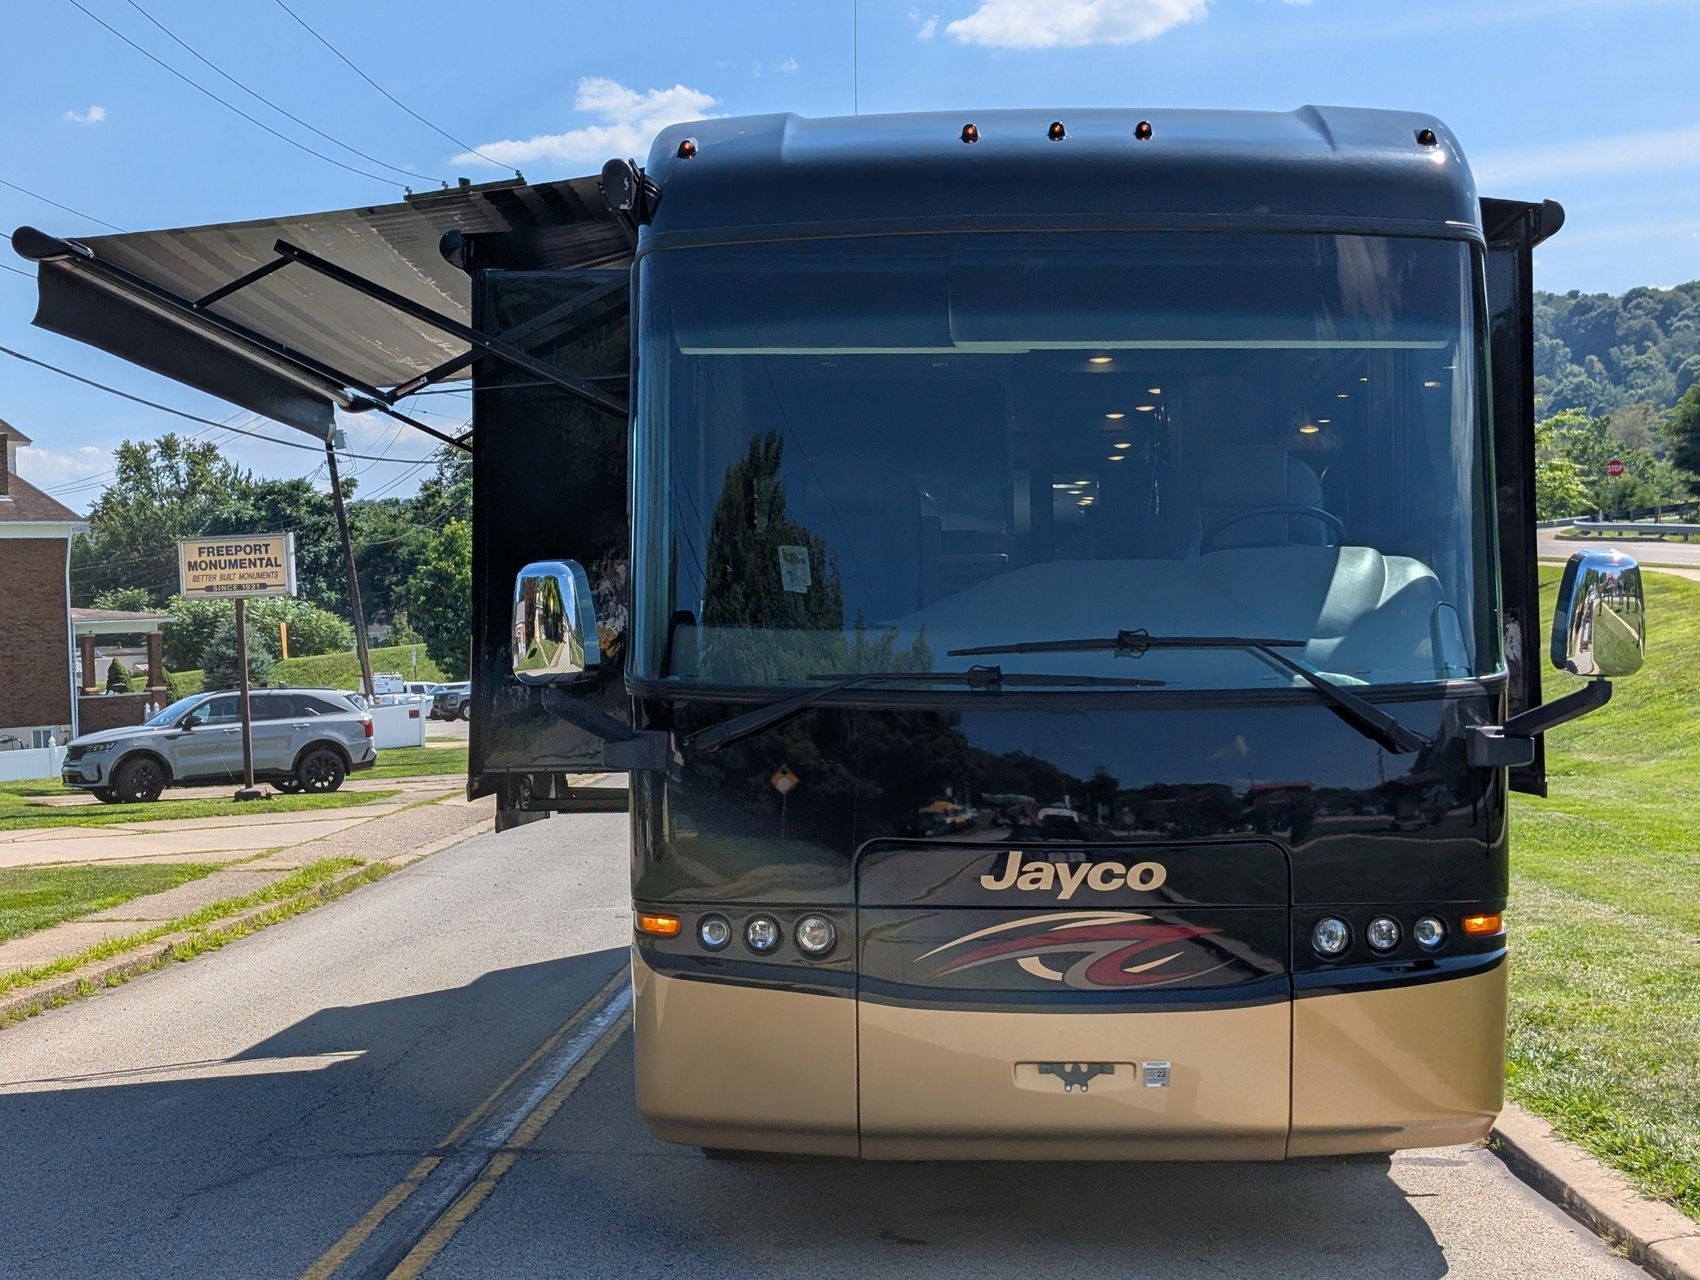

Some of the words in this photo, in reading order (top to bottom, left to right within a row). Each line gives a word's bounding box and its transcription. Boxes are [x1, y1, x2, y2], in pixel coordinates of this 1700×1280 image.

[198, 543, 271, 558] FREEPORT
[187, 556, 282, 572] MONUMENTAL
[192, 574, 217, 583] BETTER
[219, 573, 236, 582] BUILT
[239, 571, 279, 581] MONUMENTS
[980, 850, 1167, 900] Jayco
[1157, 1070, 1167, 1078] 22
